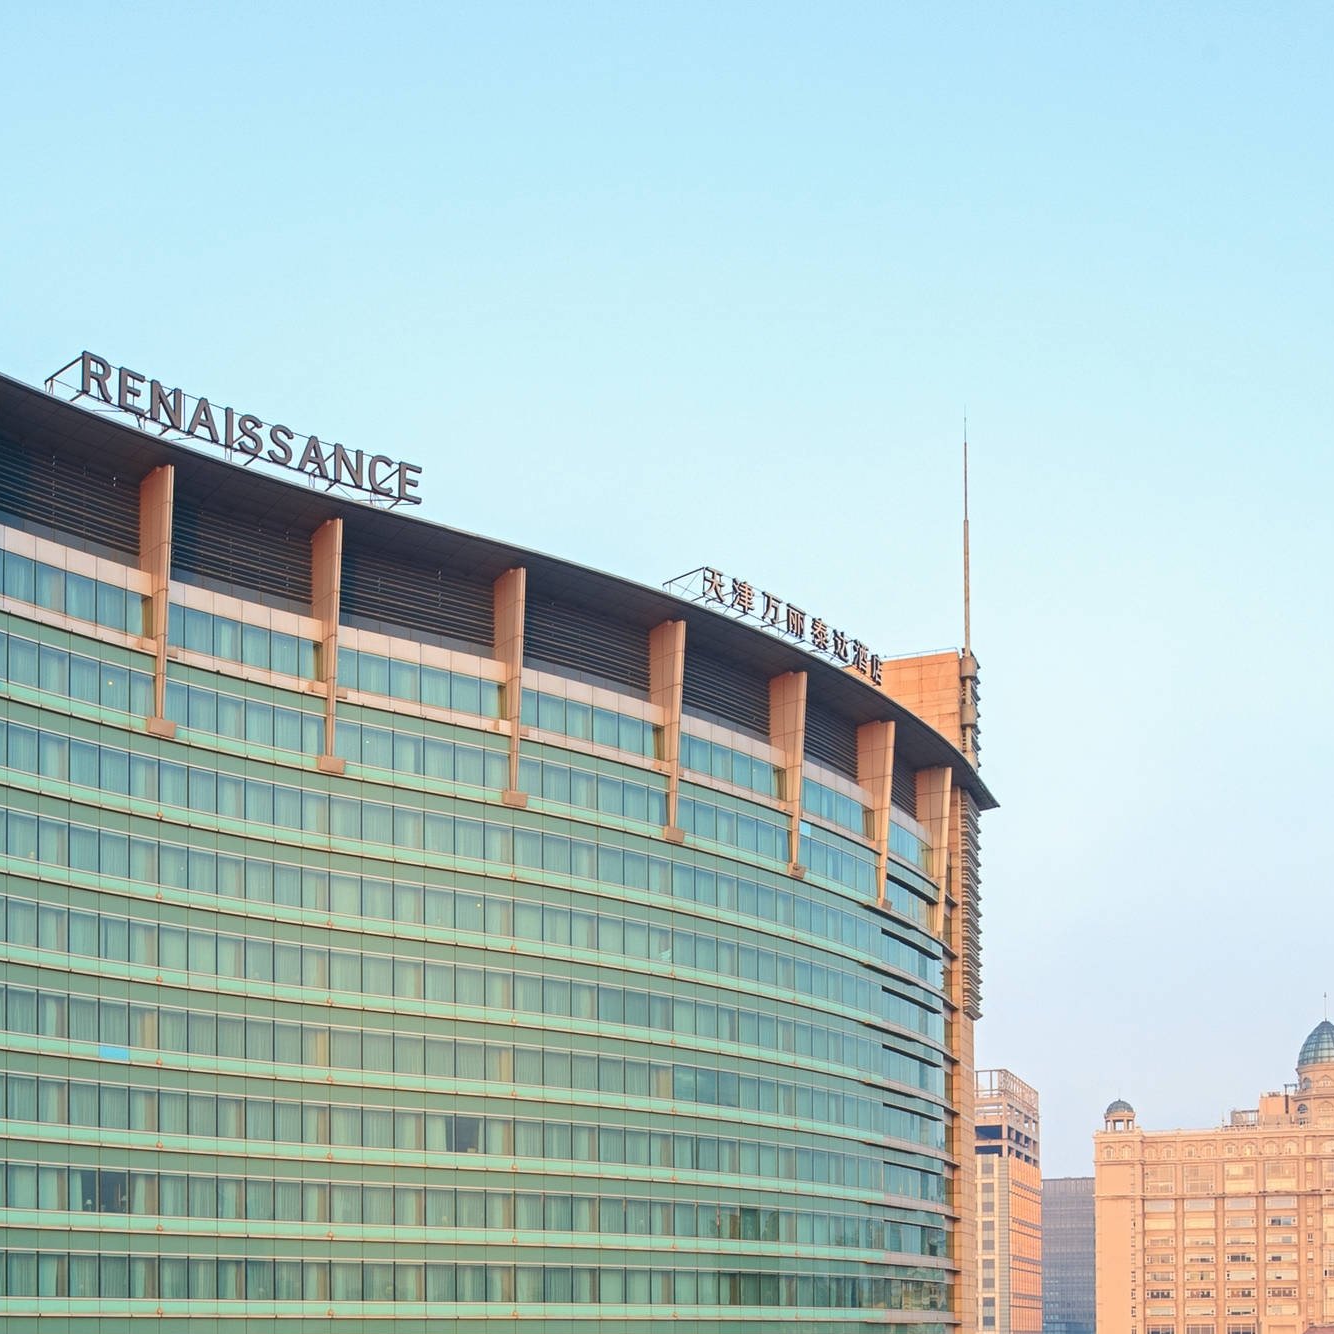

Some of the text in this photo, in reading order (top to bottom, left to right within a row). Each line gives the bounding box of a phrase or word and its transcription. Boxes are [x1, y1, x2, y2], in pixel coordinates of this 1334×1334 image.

[82, 350, 423, 505] RENAISSANCE
[703, 566, 883, 686] 天津万丽泰达酒店
